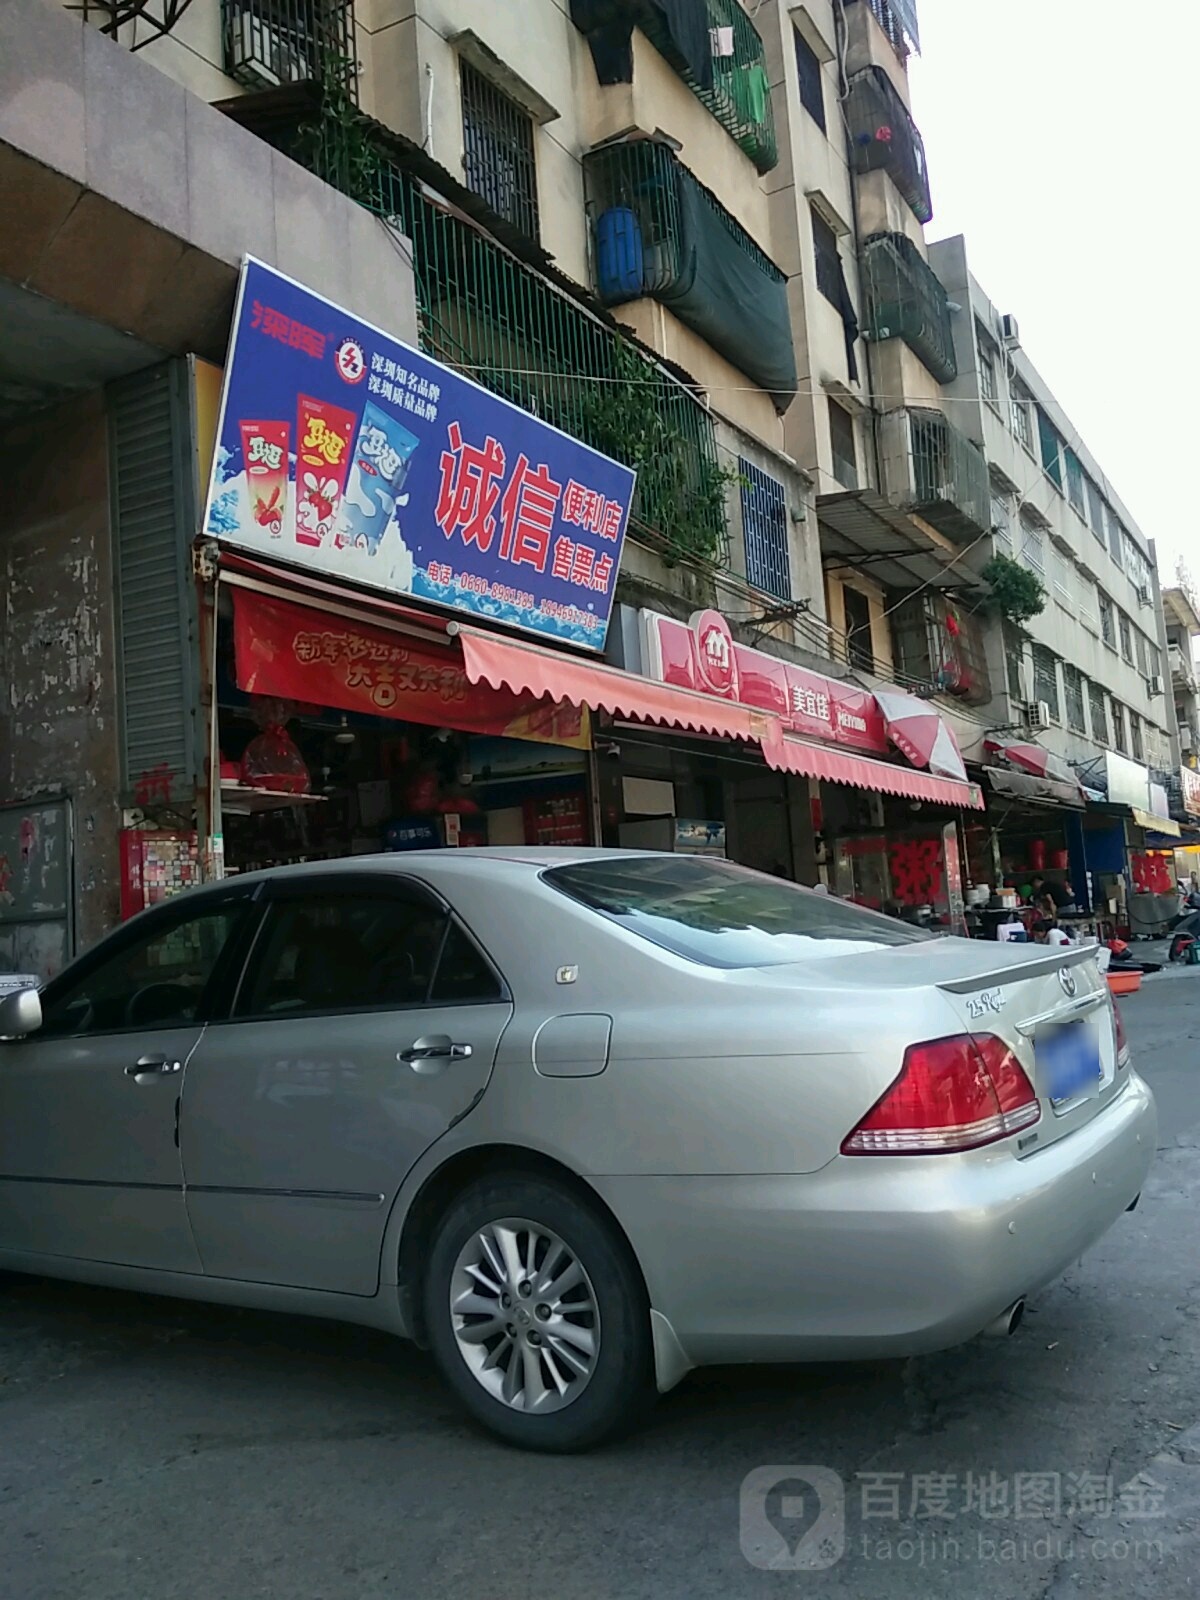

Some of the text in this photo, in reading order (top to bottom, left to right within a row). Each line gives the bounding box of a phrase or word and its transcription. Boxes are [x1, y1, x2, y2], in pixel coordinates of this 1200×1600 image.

[368, 373, 438, 422] 深圳质量品牌
[371, 352, 440, 401] 深圳知名品牌
[434, 421, 562, 573] 诚信
[562, 479, 623, 542] 便利店
[552, 535, 613, 594] 售票点
[792, 685, 830, 722] 美宜佳
